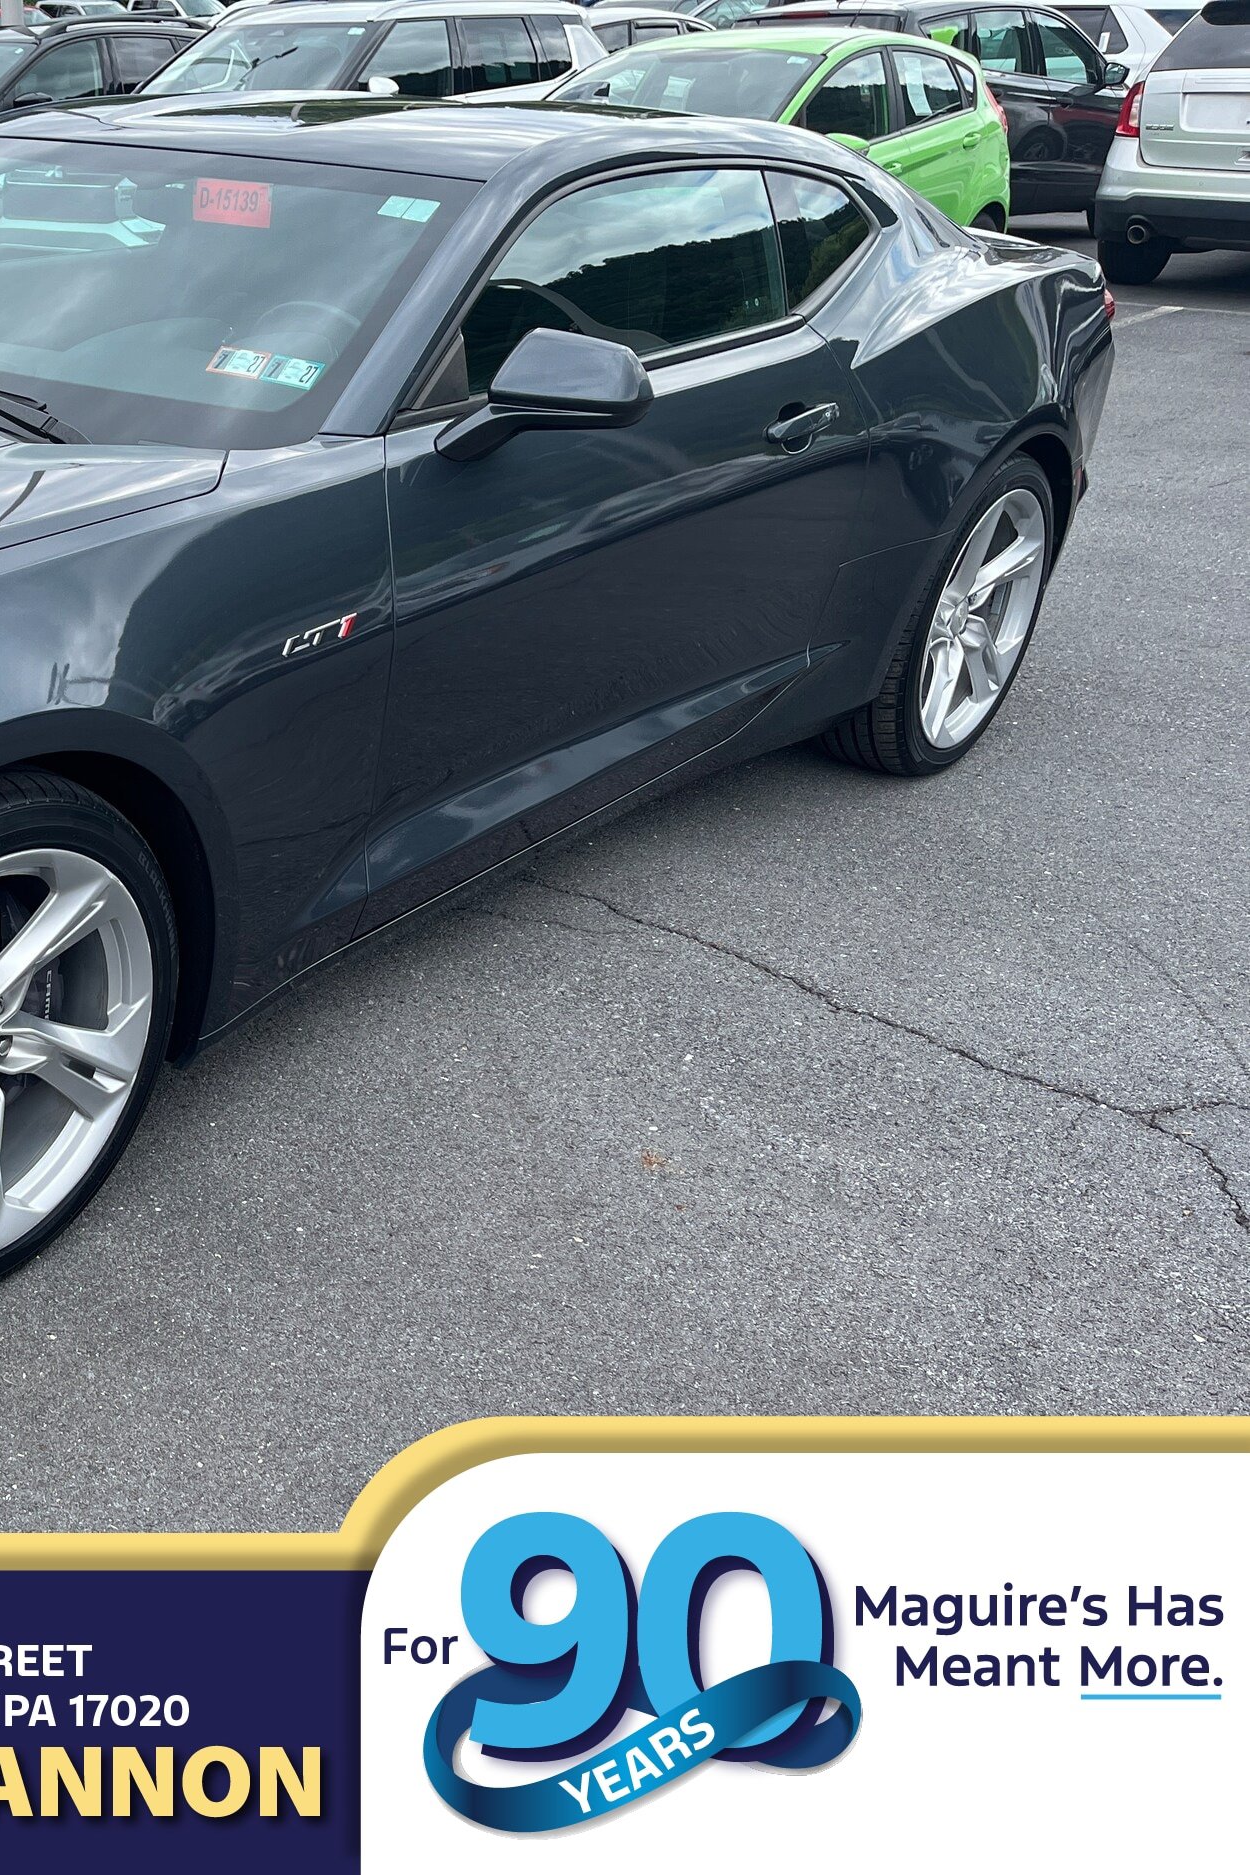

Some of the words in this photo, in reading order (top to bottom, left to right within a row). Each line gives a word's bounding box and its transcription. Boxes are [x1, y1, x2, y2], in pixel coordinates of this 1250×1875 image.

[200, 187, 259, 212] D-15139
[246, 355, 266, 374] 27
[298, 365, 319, 384] 27
